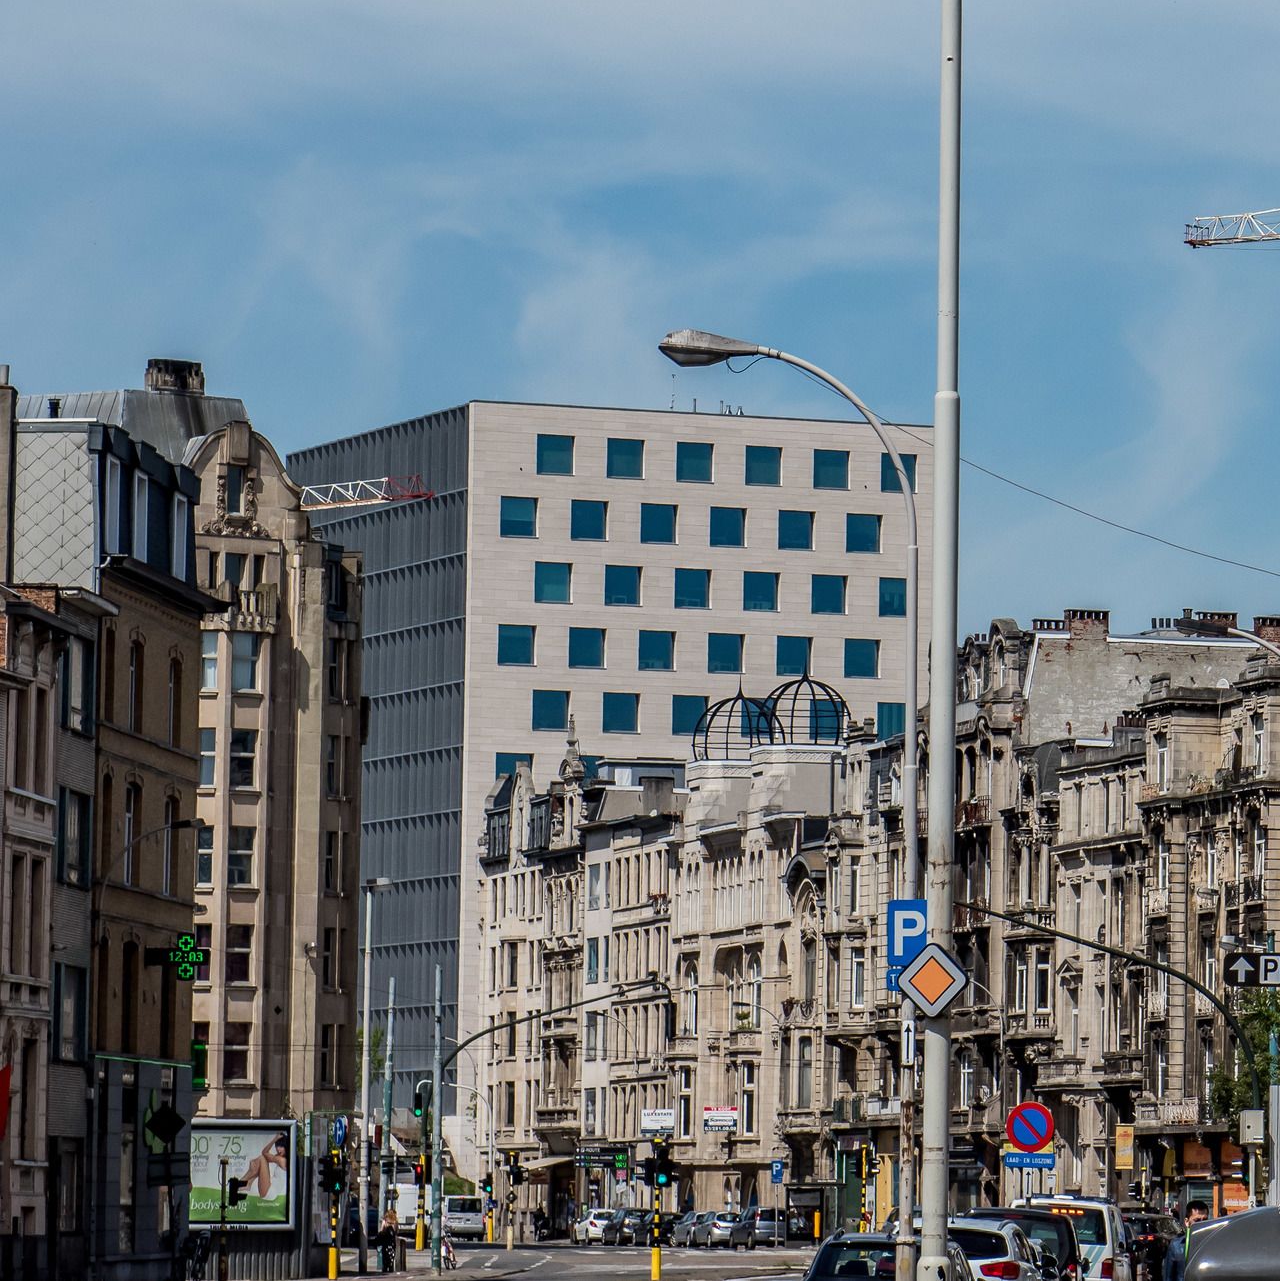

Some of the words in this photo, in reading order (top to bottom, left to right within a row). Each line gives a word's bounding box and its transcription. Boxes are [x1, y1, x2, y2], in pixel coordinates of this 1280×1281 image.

[894, 911, 926, 957] P
[168, 951, 204, 962] 12:03
[772, 1162, 781, 1175] P
